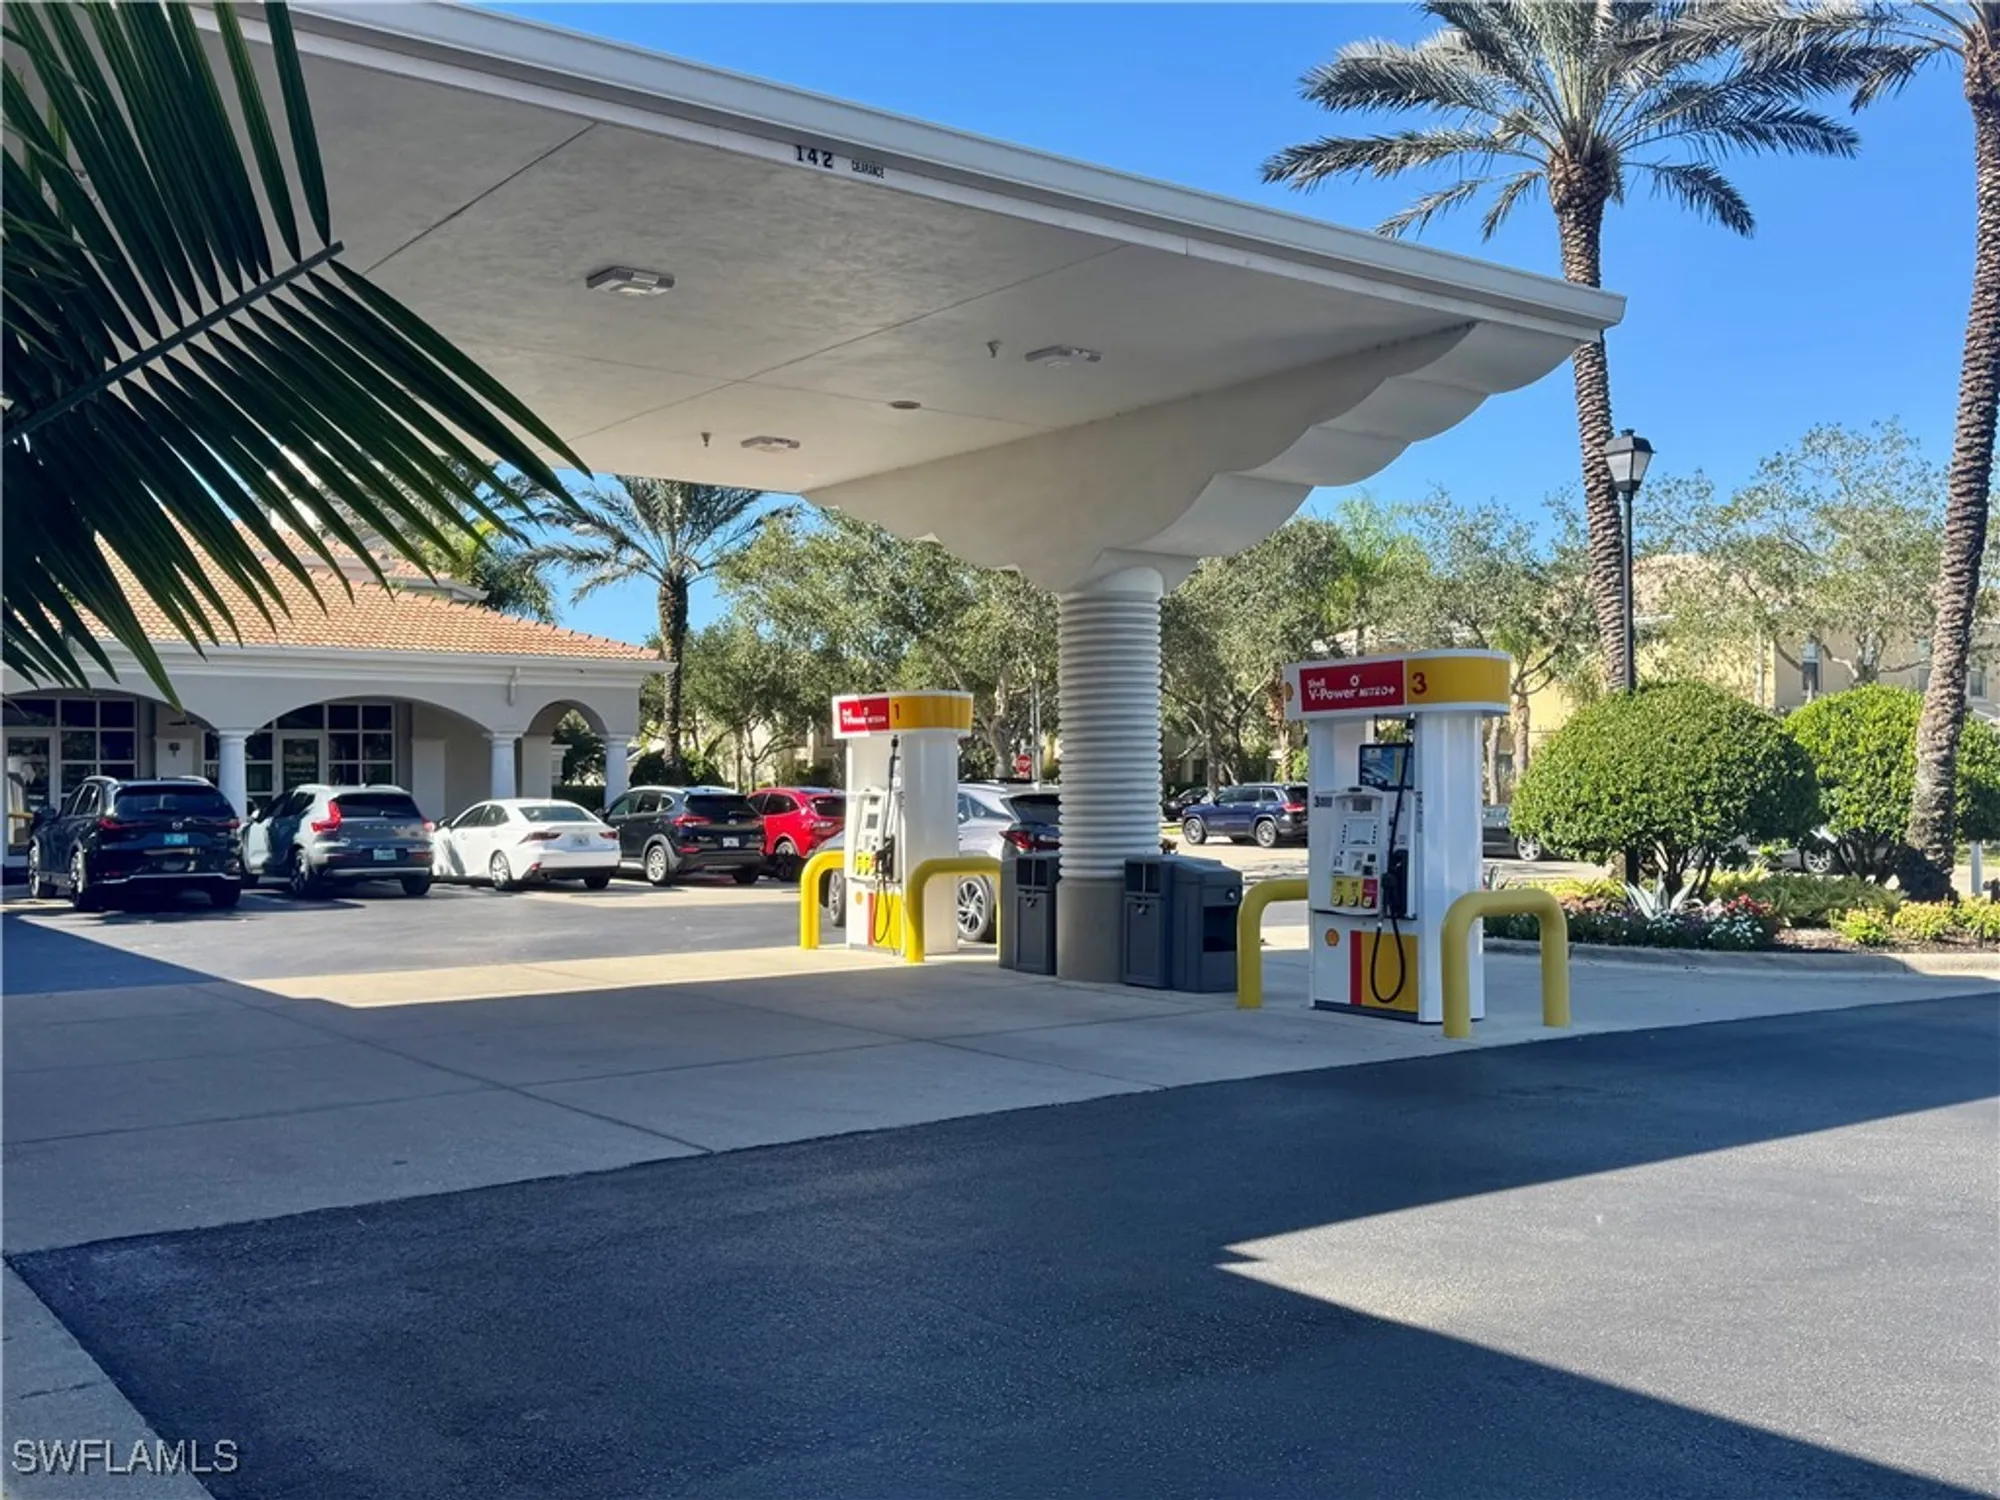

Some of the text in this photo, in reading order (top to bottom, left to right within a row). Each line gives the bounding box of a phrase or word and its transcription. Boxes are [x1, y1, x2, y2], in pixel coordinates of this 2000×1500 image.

[1411, 671, 1428, 695] 3
[1308, 686, 1357, 700] V-Power
[894, 702, 900, 720] 1
